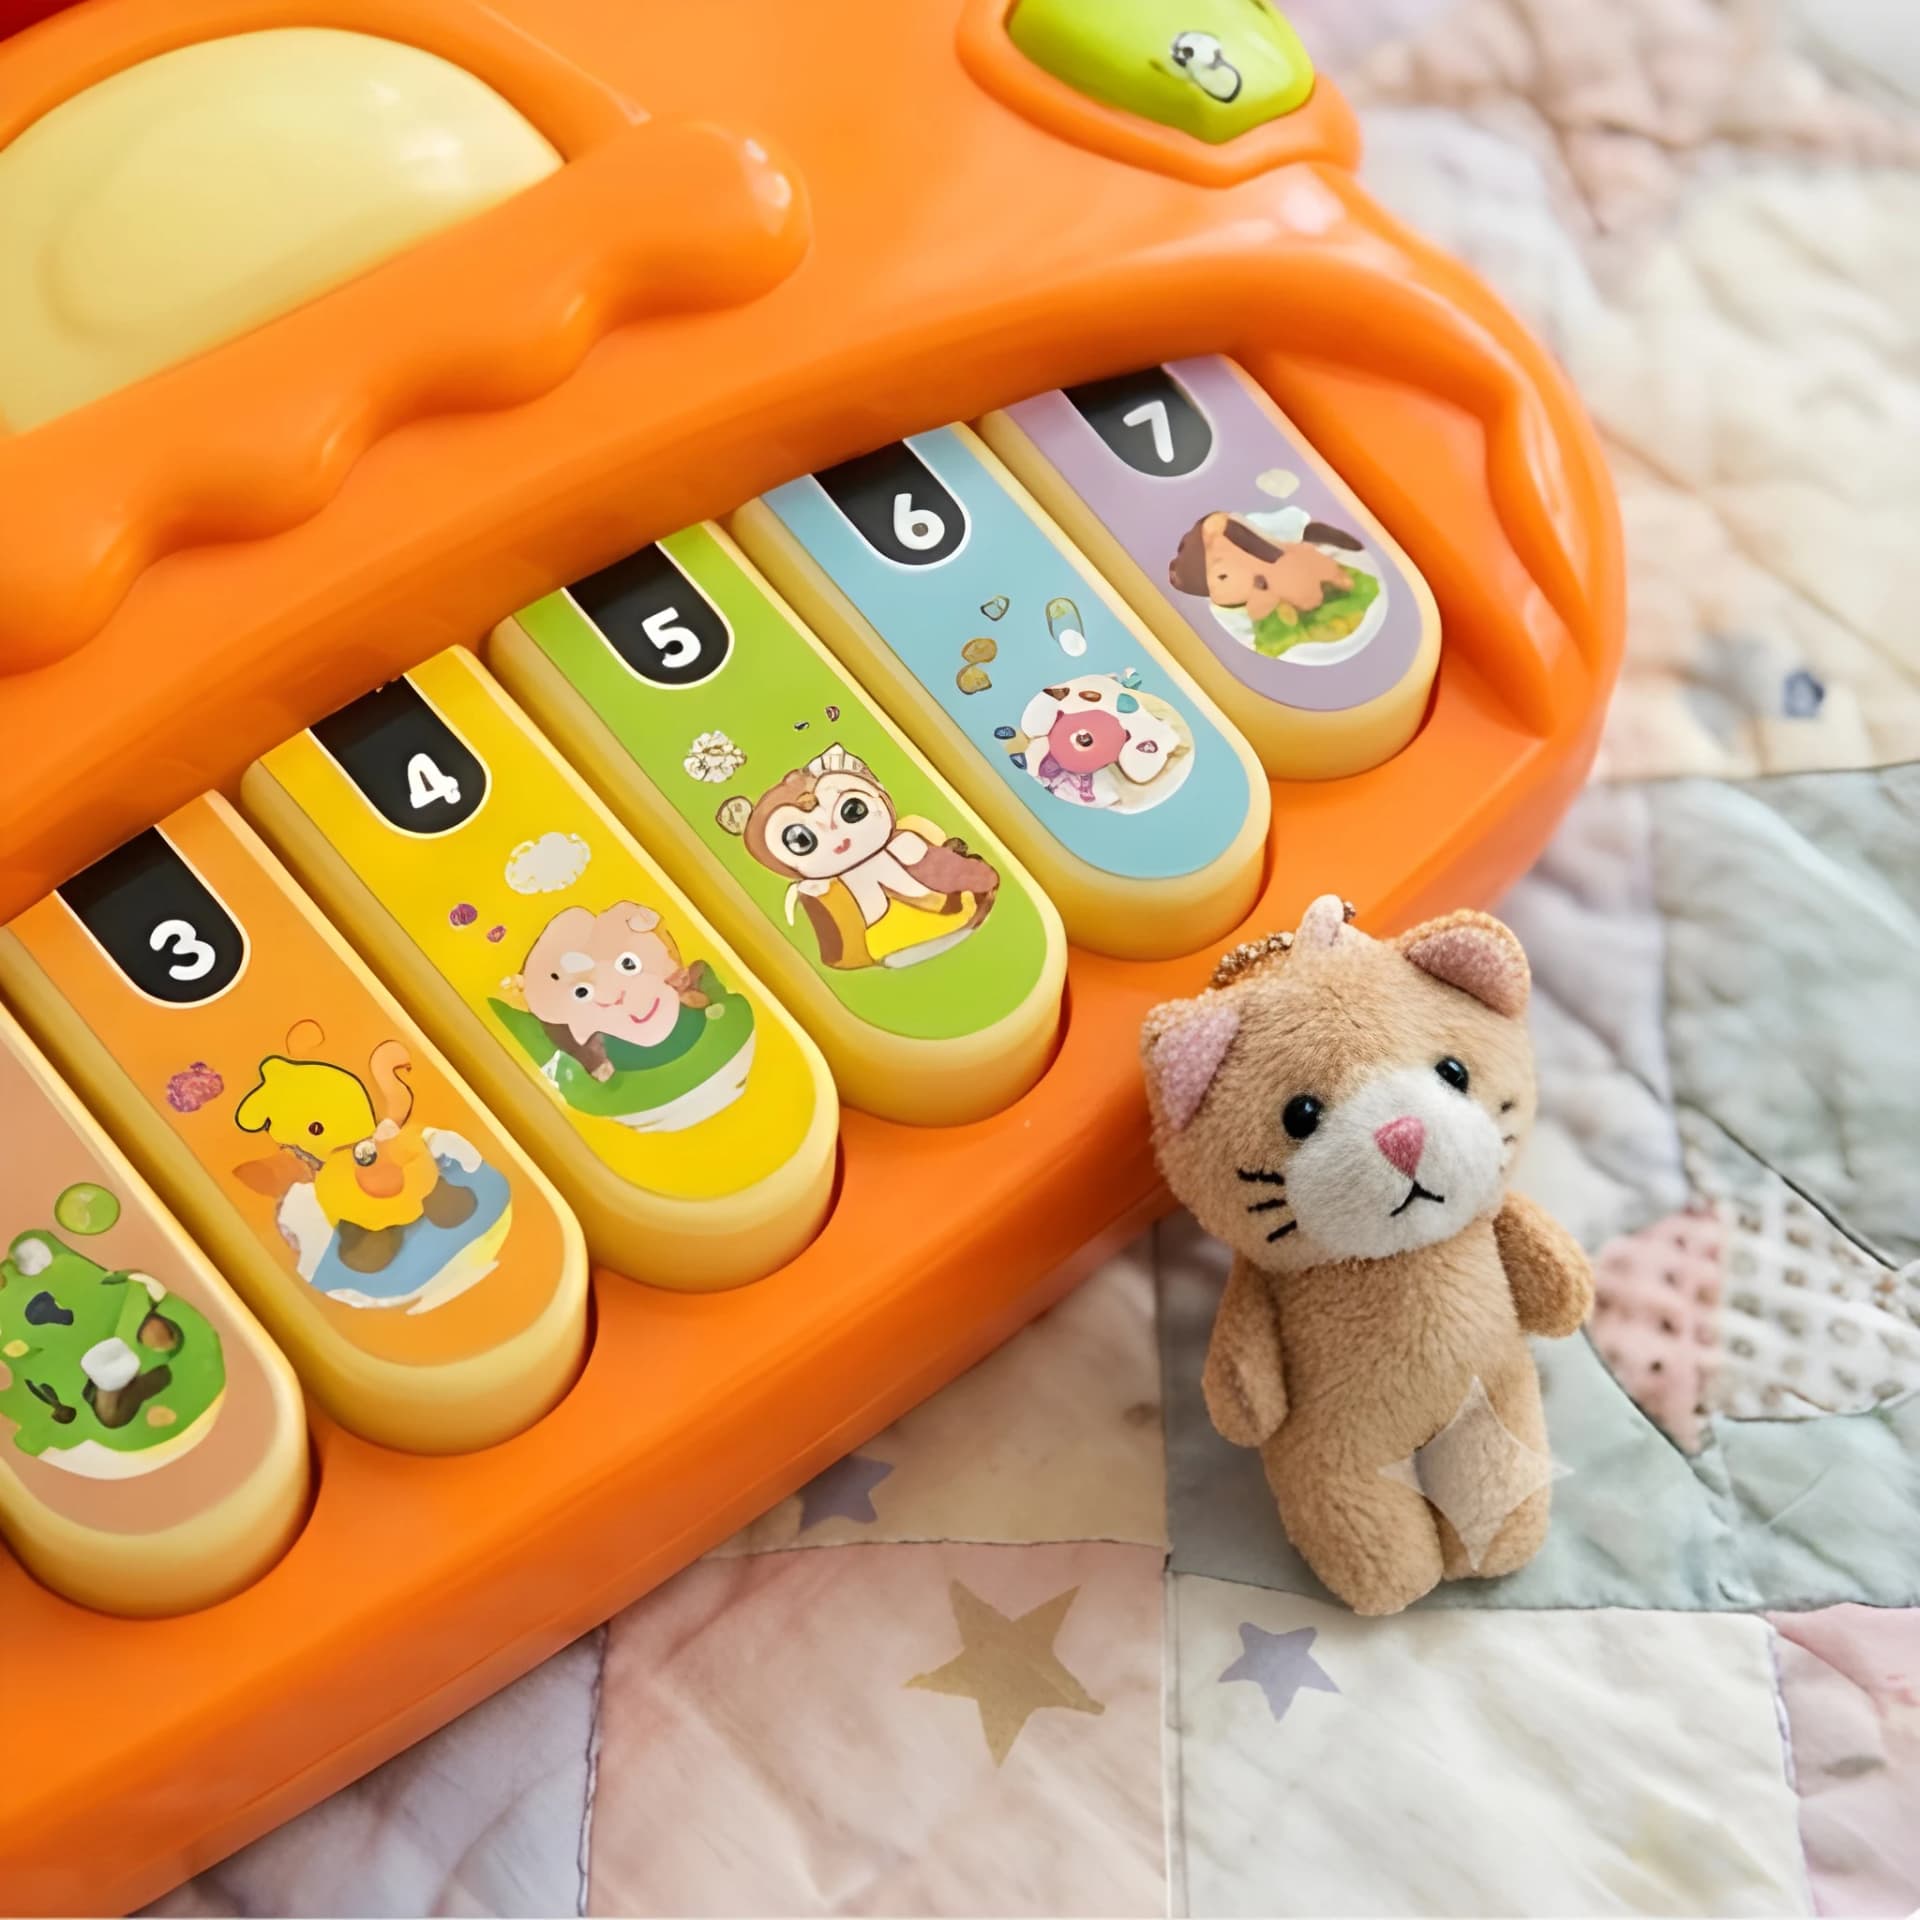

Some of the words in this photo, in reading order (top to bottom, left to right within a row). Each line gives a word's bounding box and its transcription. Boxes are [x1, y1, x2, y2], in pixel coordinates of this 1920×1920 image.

[1122, 400, 1176, 464] 7
[893, 492, 946, 551] 6
[641, 607, 702, 668] 5
[407, 752, 461, 809] 4
[149, 919, 216, 981] 3
